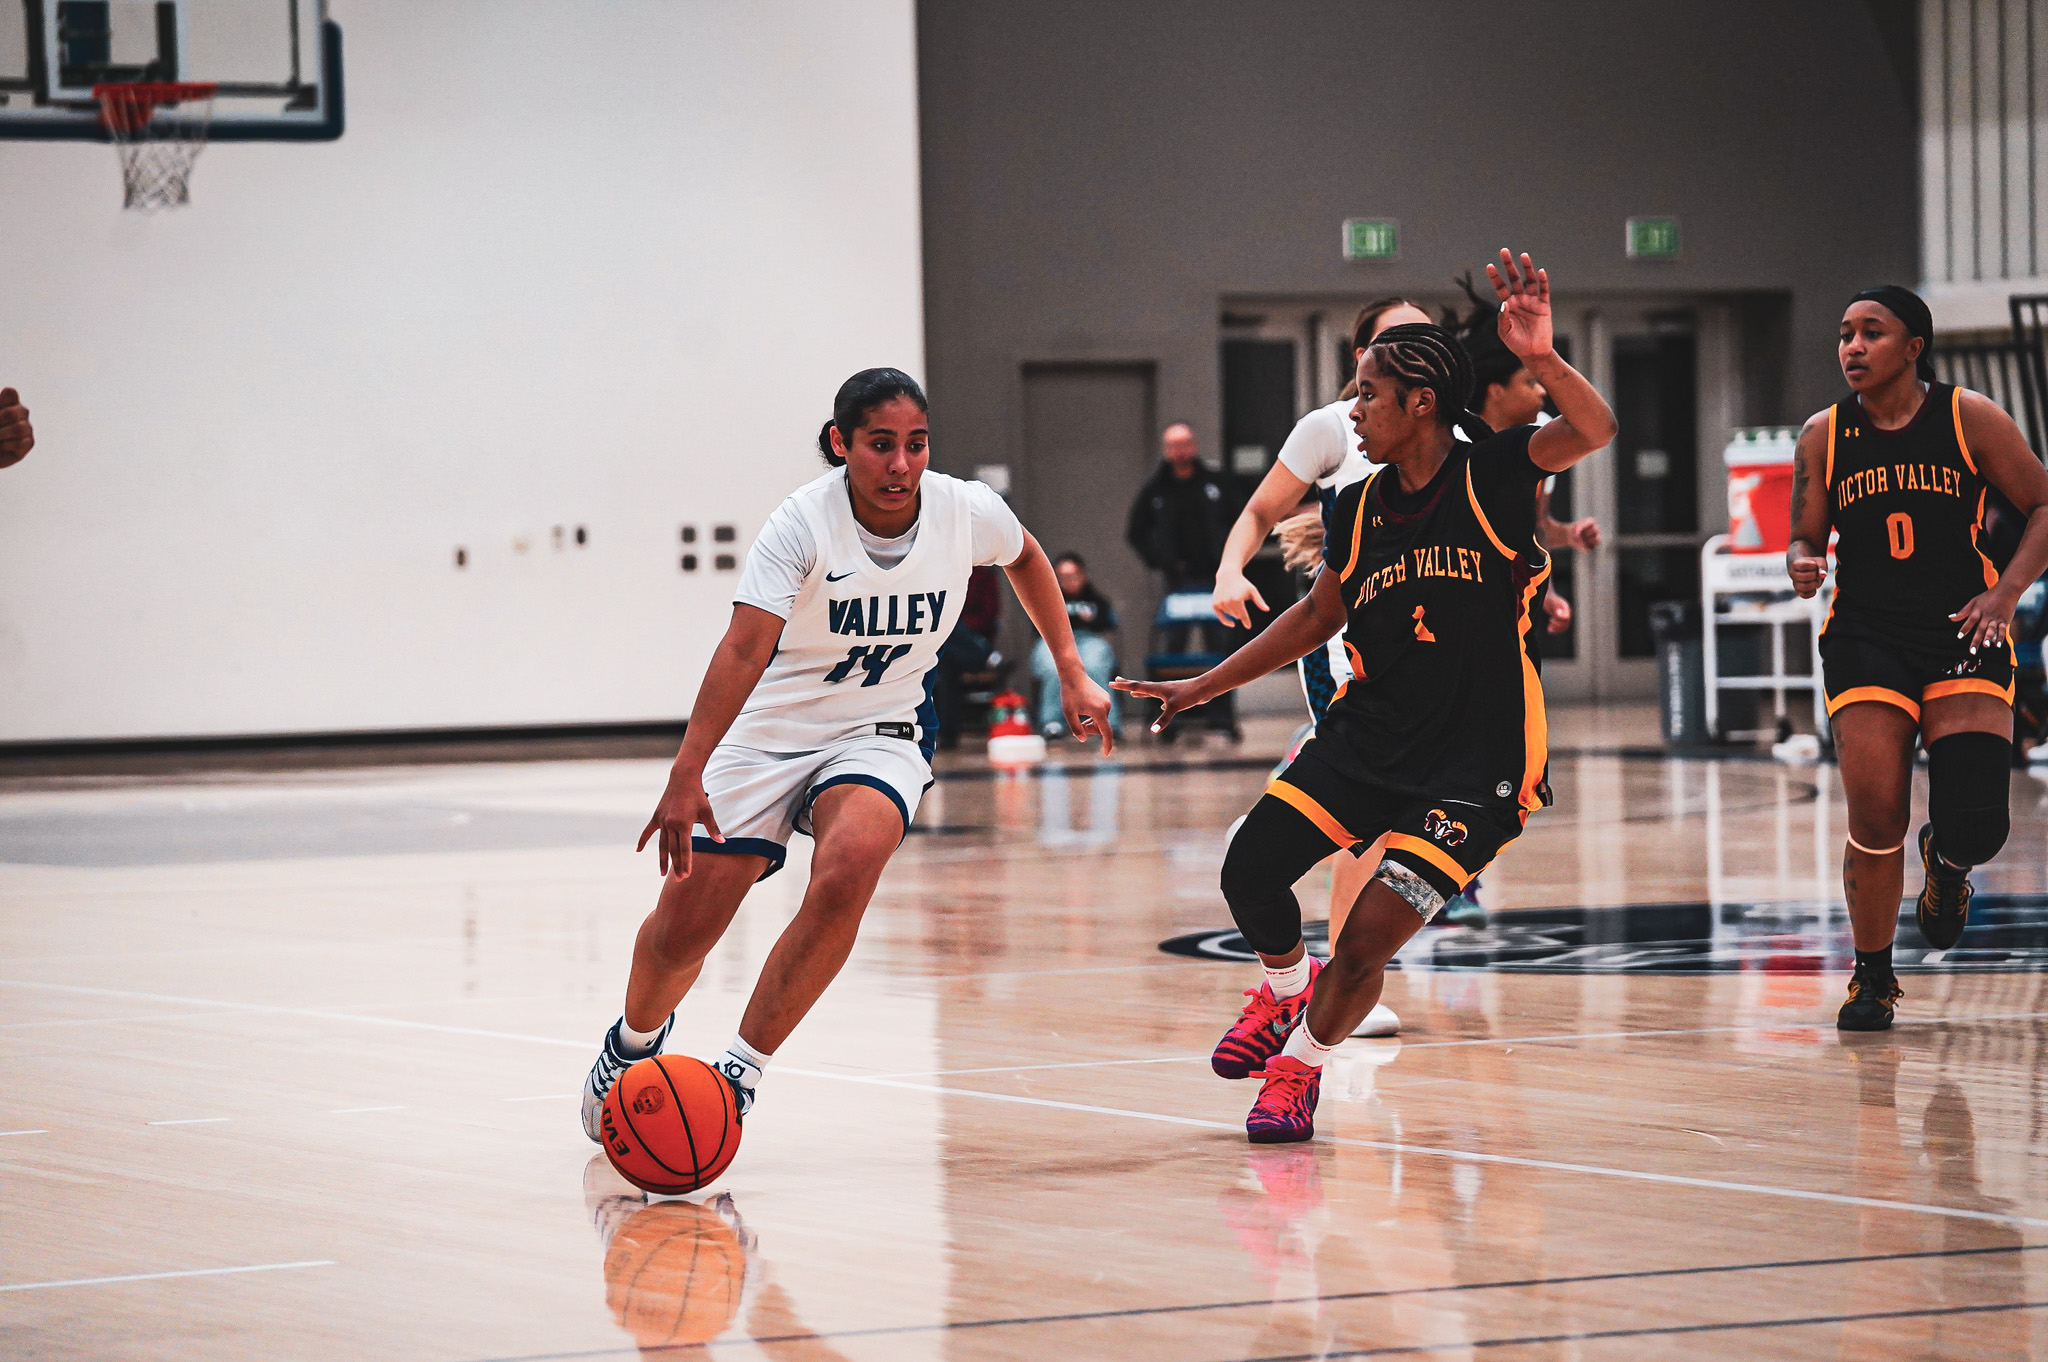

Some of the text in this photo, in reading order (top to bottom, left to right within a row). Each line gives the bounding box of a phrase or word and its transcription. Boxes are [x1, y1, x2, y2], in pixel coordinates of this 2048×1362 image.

[1895, 464, 1960, 497] VALLEY
[1886, 512, 1914, 560] 0
[1413, 546, 1482, 583] VALLEY
[829, 590, 947, 636] VALLEY
